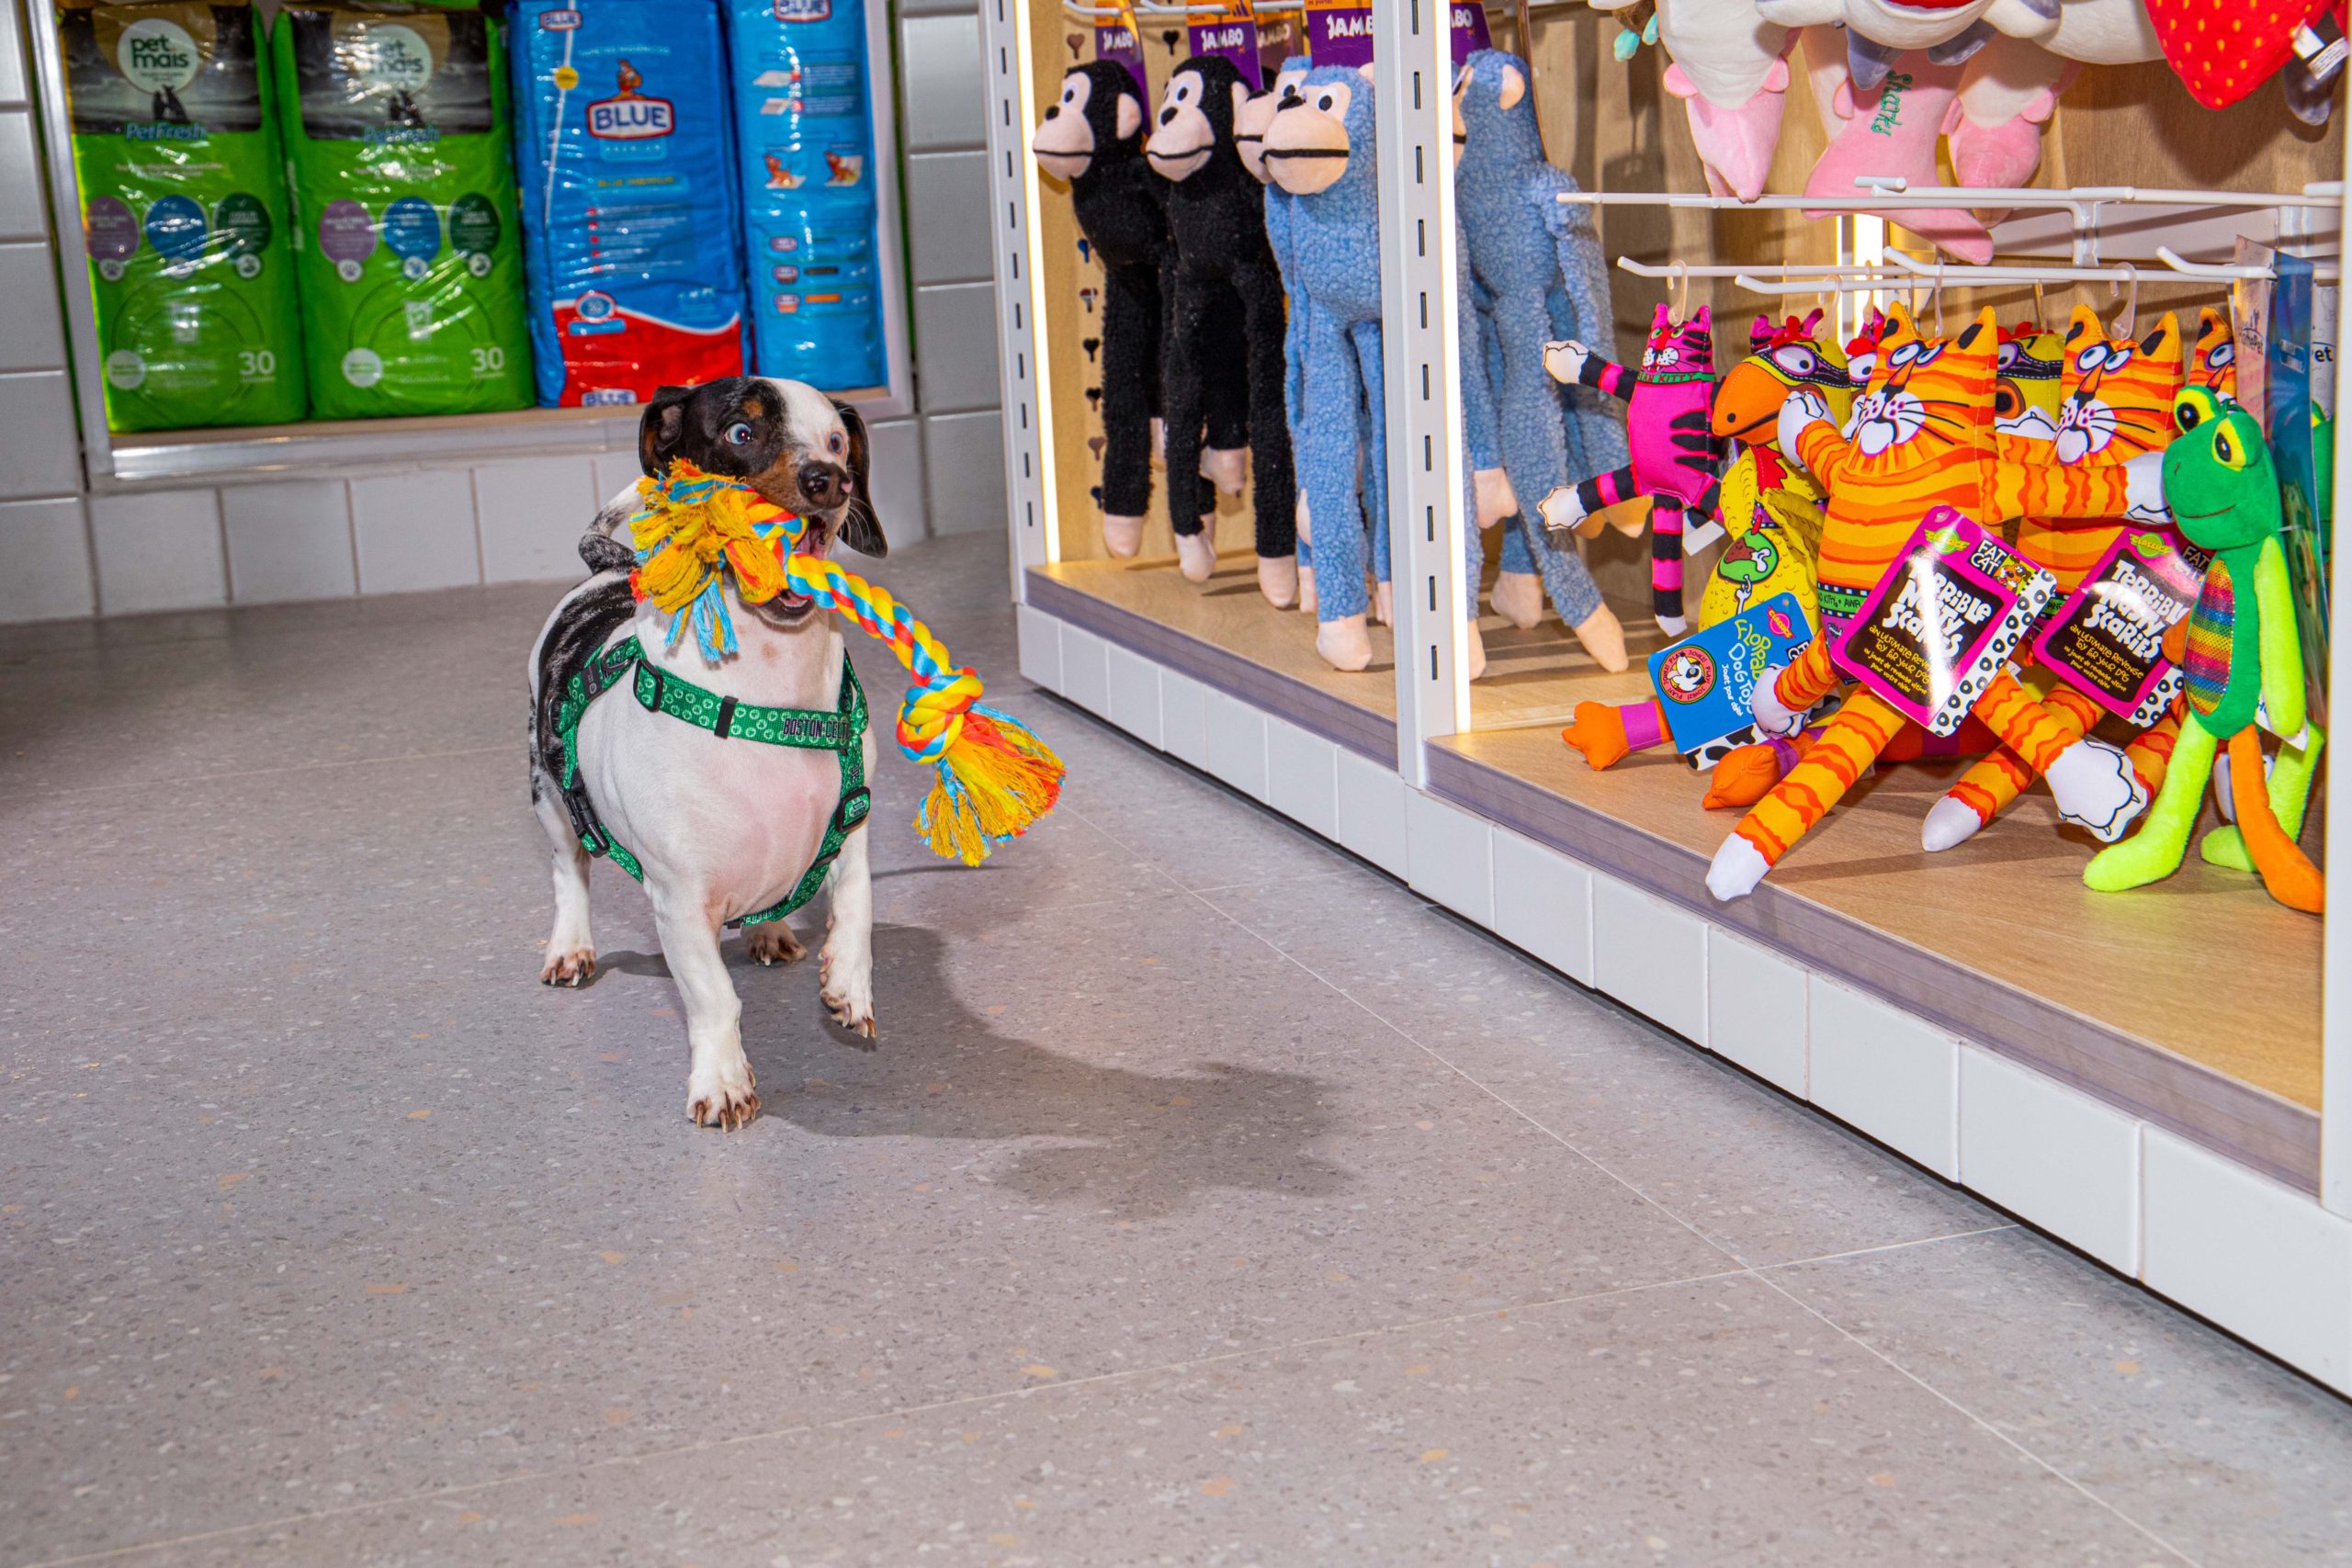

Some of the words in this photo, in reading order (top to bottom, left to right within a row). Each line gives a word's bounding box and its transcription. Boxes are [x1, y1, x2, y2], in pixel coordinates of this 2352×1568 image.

[1201, 28, 1244, 51] JAMBO
[1326, 14, 1373, 40] JAMB
[131, 52, 189, 69] mais
[594, 105, 667, 130] BLUE
[125, 121, 207, 141] PetFresh
[237, 349, 276, 377] 30
[469, 346, 504, 373] 30
[1977, 538, 2008, 563] FAT
[2182, 544, 2211, 569] FAT
[1971, 552, 1999, 576] CAT
[783, 718, 822, 737] BOSTON
